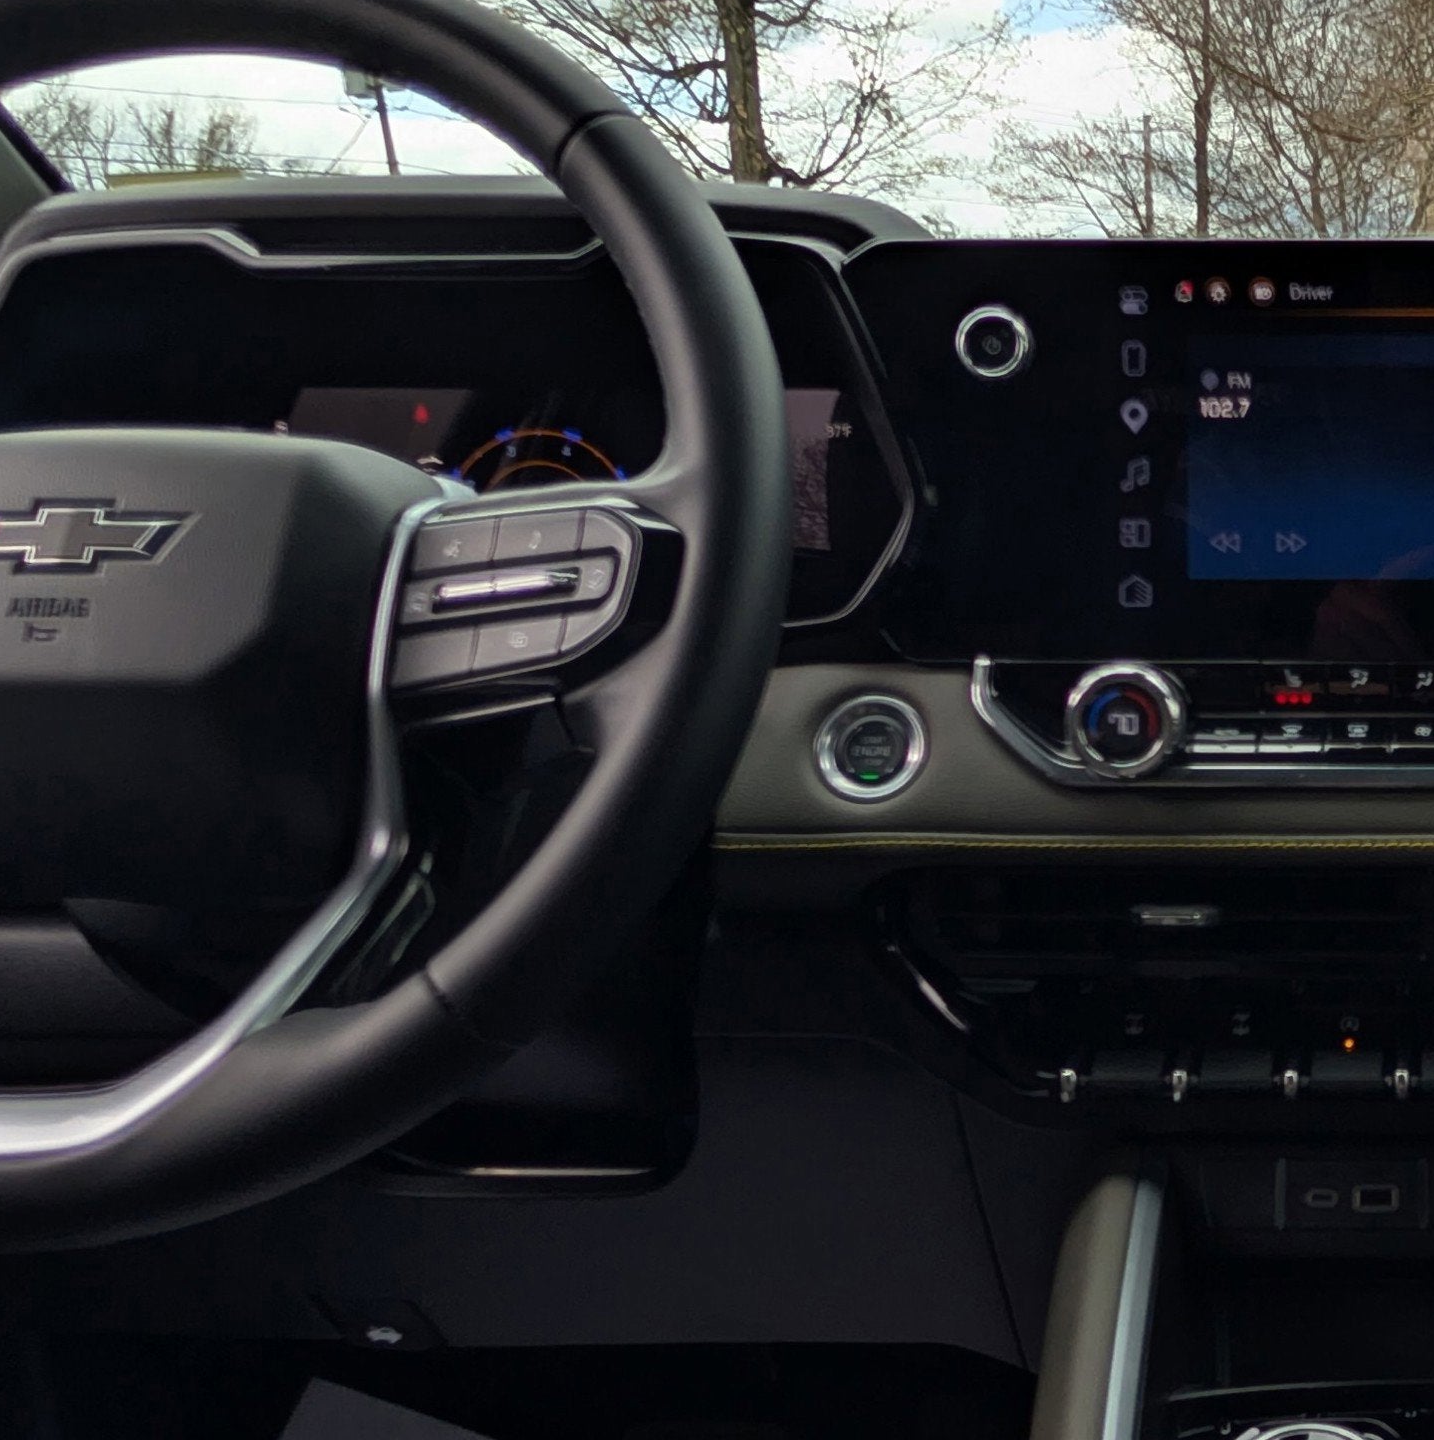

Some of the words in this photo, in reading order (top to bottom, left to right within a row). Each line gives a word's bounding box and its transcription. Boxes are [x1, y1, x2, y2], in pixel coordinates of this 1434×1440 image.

[1288, 282, 1334, 301] Driver
[1226, 371, 1252, 390] FM
[1108, 712, 1140, 736] 70
